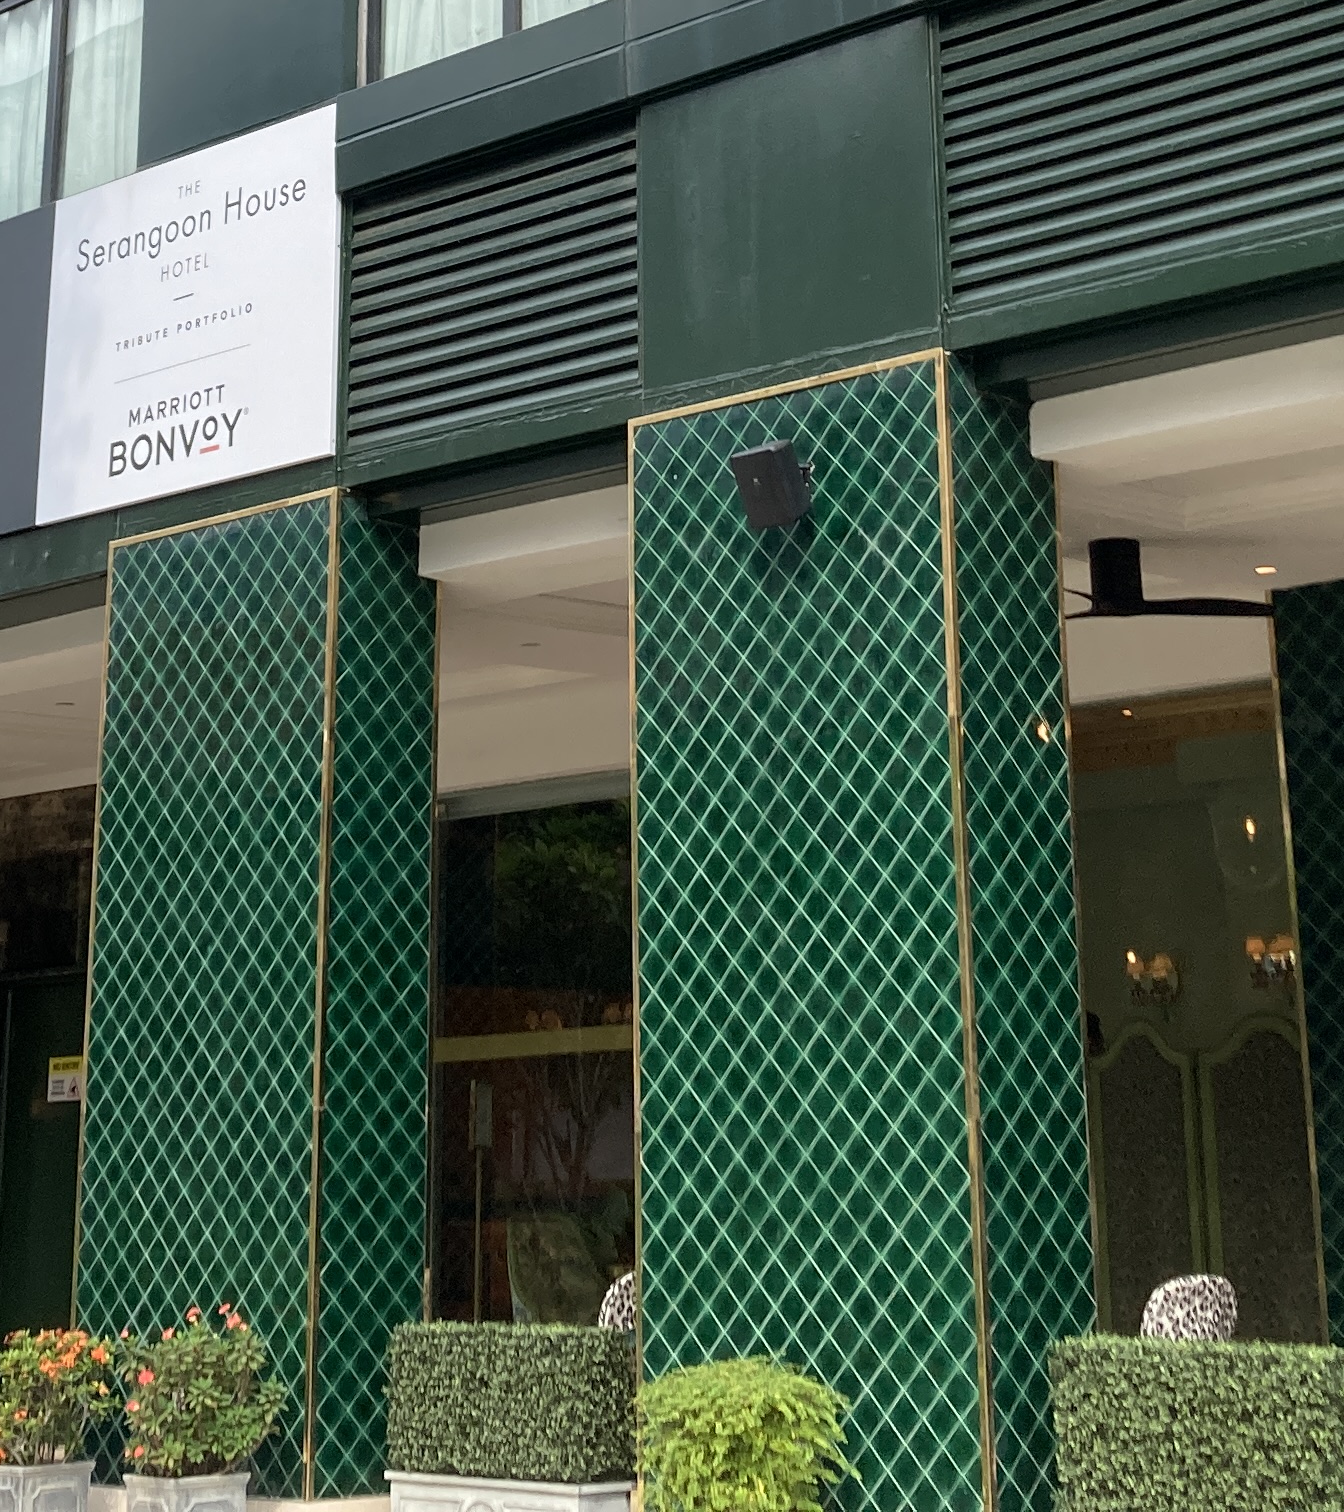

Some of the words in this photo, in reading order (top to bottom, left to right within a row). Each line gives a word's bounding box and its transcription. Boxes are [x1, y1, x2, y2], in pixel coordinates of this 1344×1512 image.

[177, 180, 200, 199] THE
[76, 208, 211, 272] Serangoon
[223, 177, 307, 225] House
[160, 252, 209, 283] HOTEL
[115, 327, 169, 352] TRIBUTE
[176, 302, 253, 334] PORTFOLIO
[128, 384, 225, 428] MARRIOTT
[108, 408, 243, 478] BONVOY
